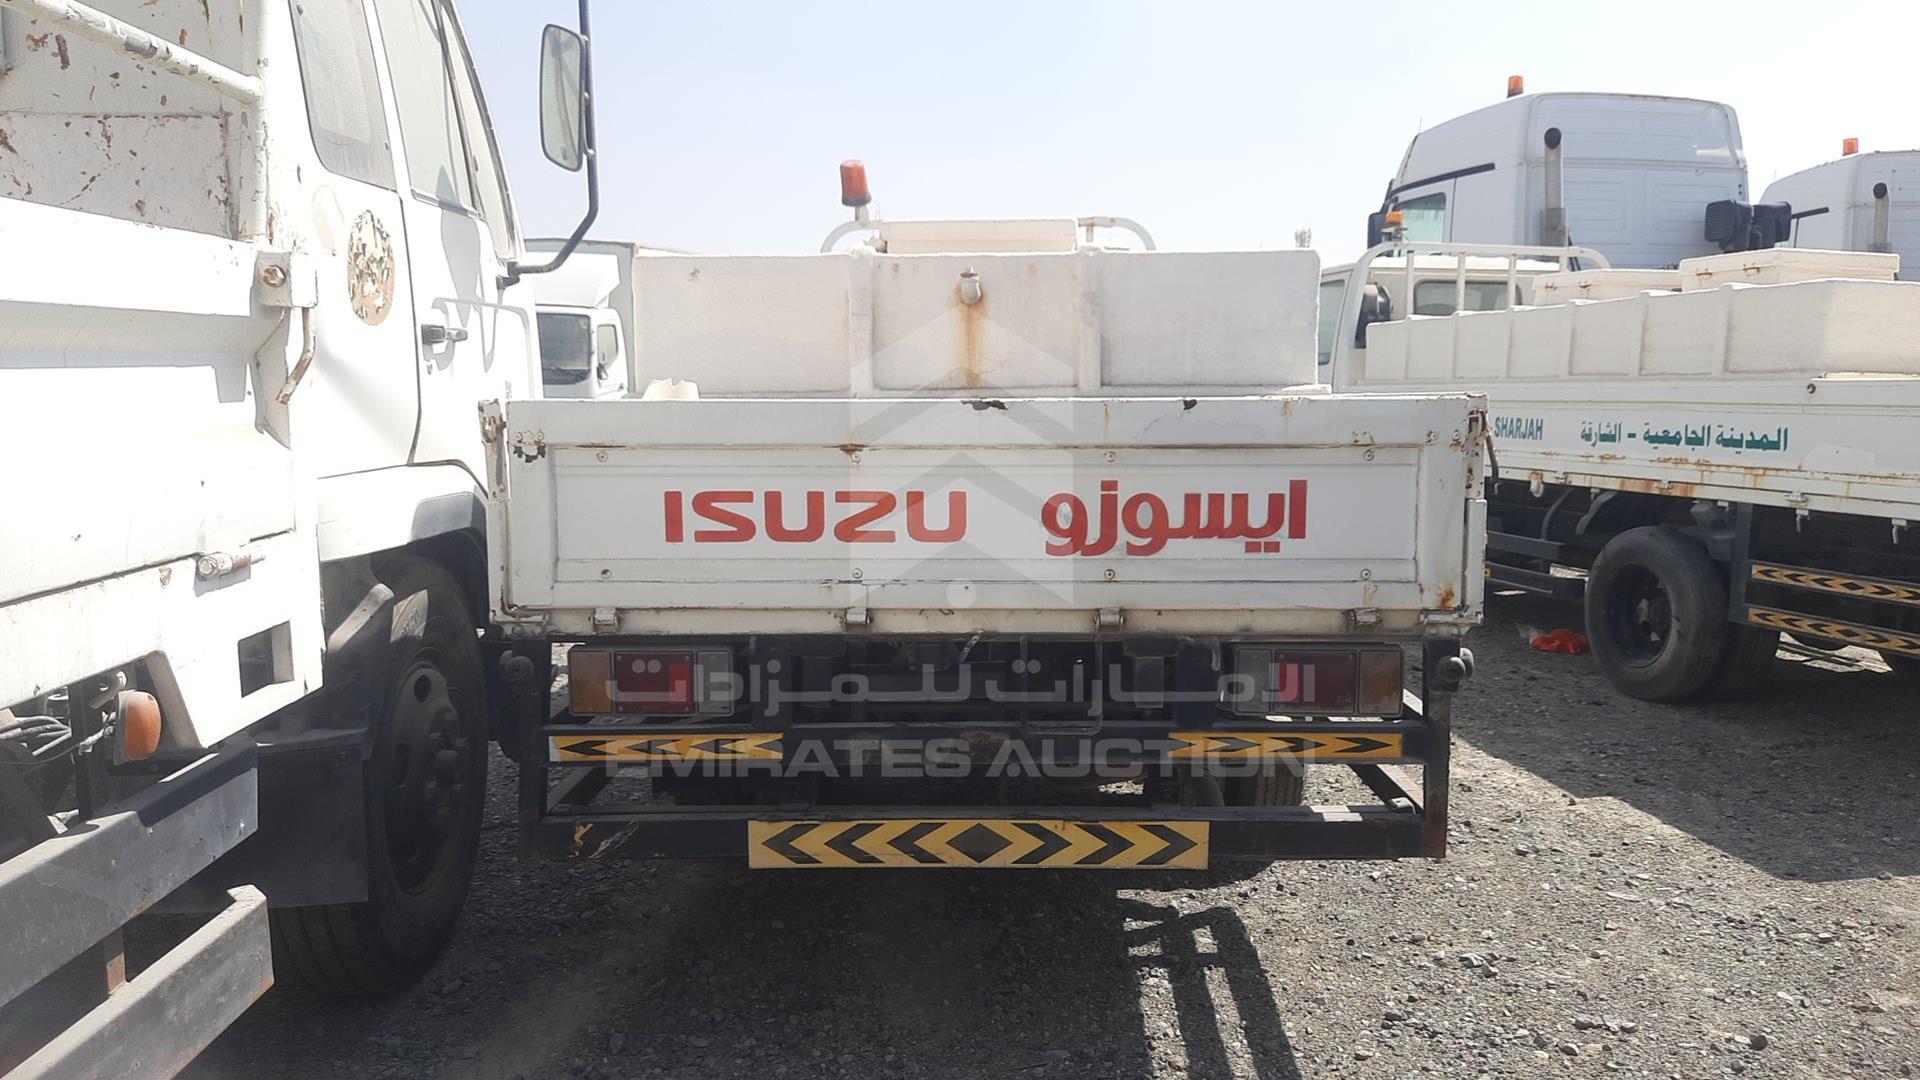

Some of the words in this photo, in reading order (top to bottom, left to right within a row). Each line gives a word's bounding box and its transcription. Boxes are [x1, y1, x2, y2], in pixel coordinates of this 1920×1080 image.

[1494, 417, 1543, 440] SHARJAH
[1580, 421, 1622, 447] الشارقة
[1643, 422, 1711, 451] الجامعية
[1715, 424, 1788, 454] المدينة
[664, 490, 967, 543] ISUZU
[1041, 480, 1307, 557] ايسوزو
